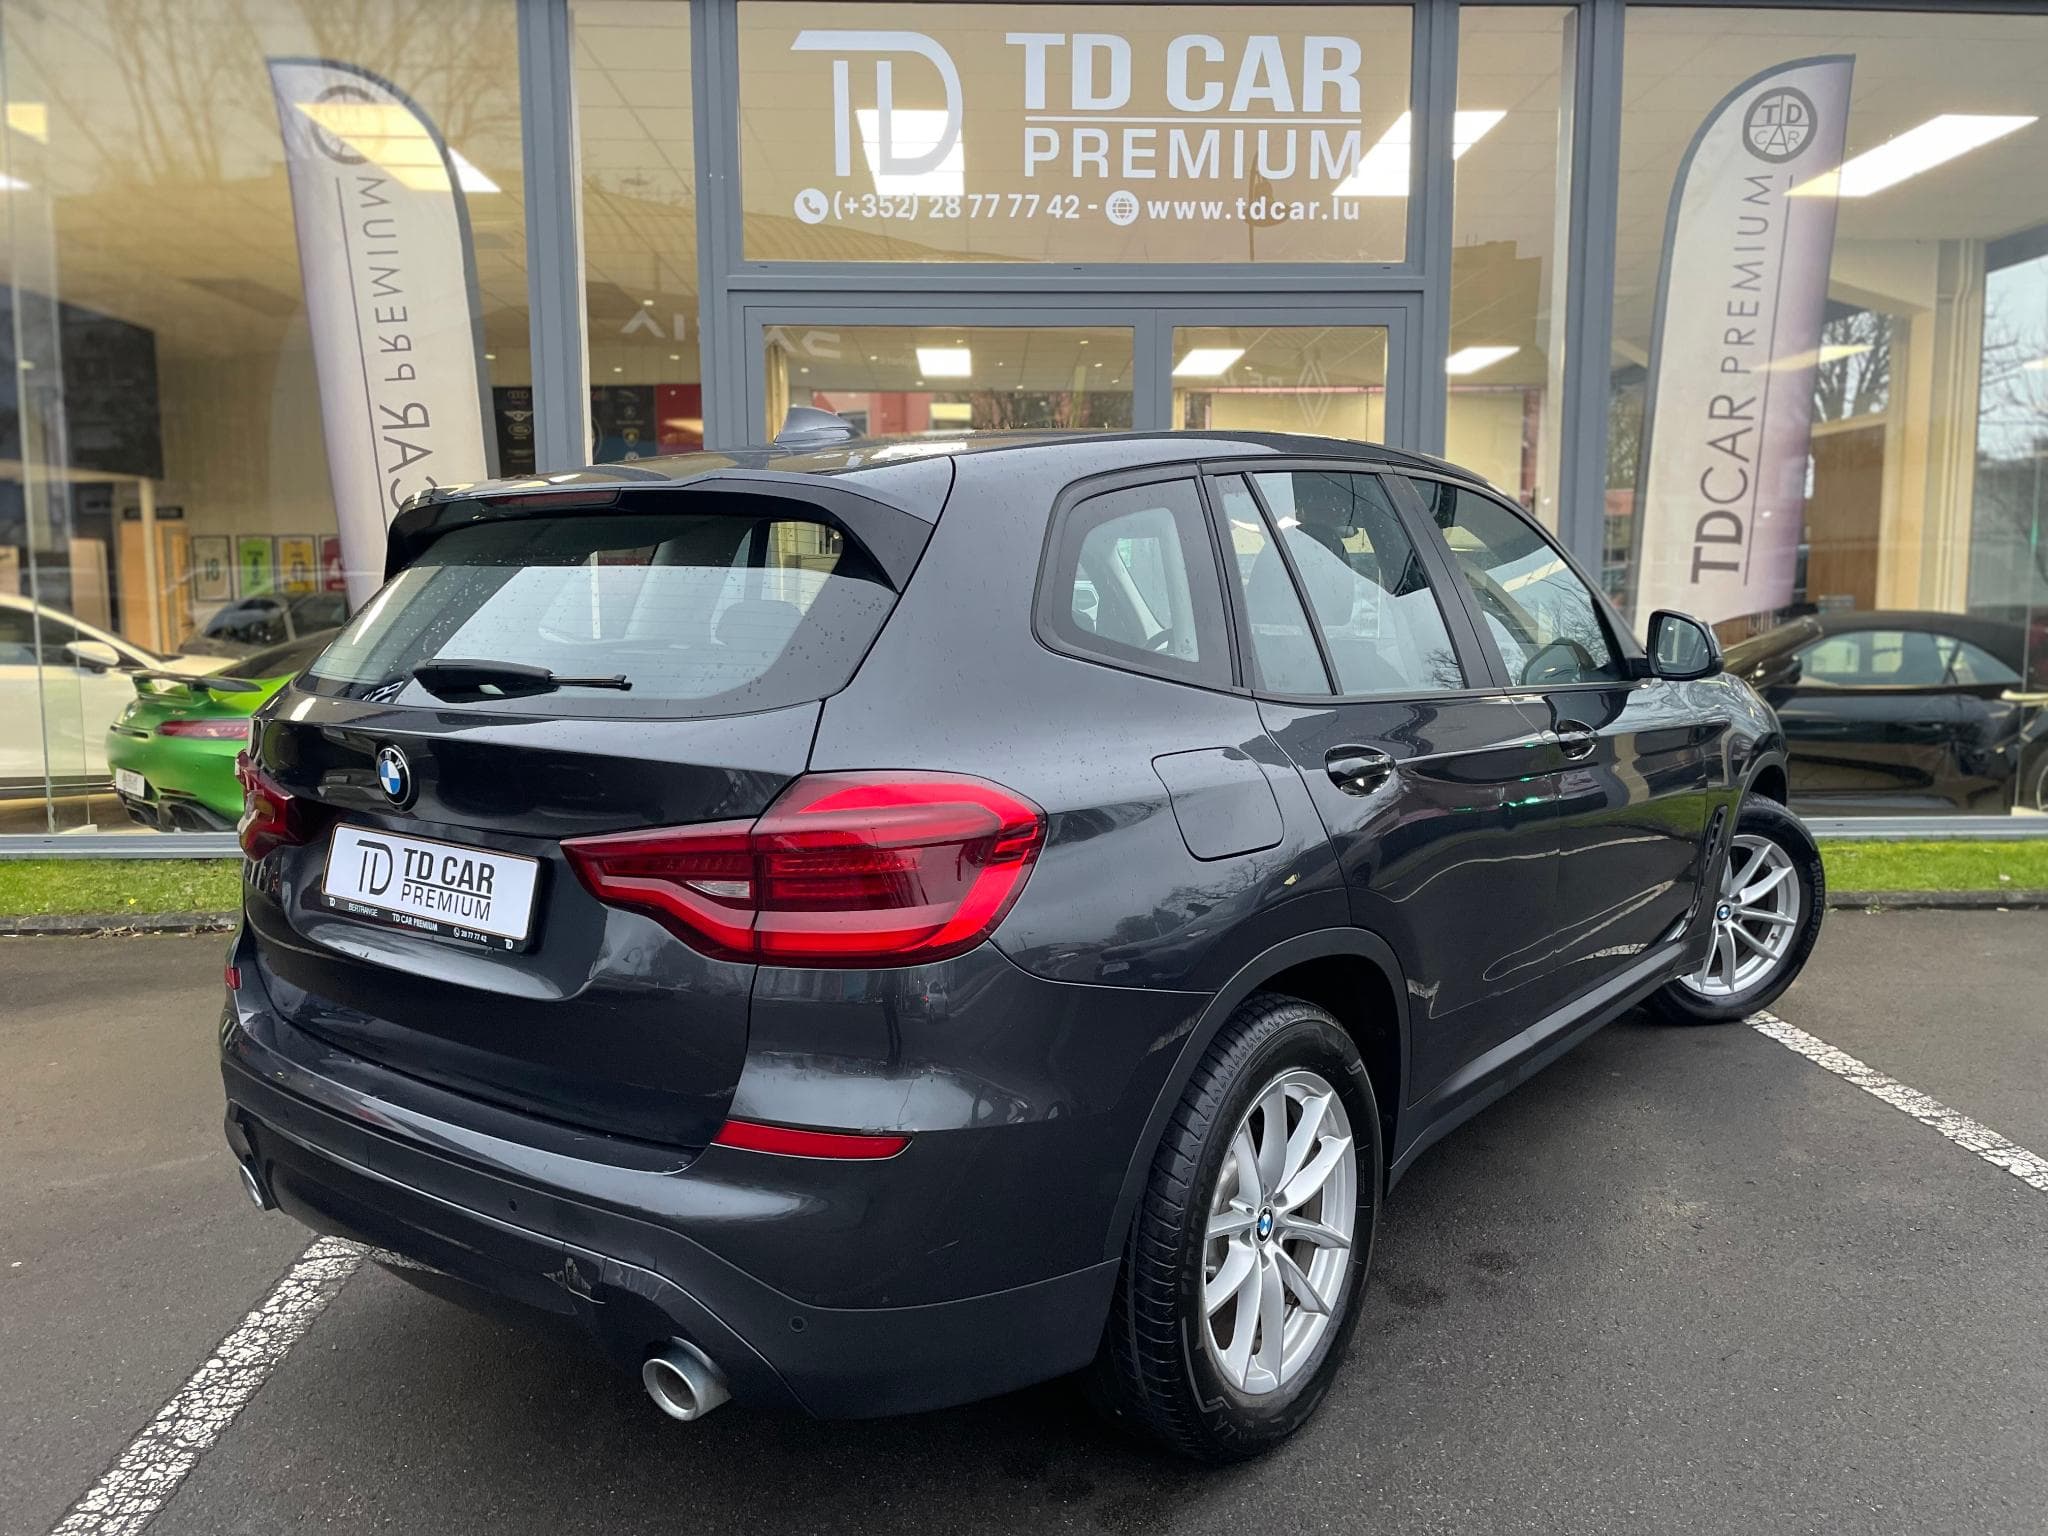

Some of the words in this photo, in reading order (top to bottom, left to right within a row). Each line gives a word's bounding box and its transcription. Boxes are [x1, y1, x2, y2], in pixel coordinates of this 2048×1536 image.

[1006, 32, 1131, 110] TD
[1166, 34, 1361, 113] CAR
[1024, 127, 1361, 180] PREMIUM
[833, 191, 919, 220] (+352)
[929, 194, 961, 218] 28
[967, 194, 1000, 218] 77
[1007, 194, 1041, 218] 77
[1046, 194, 1080, 219] 42
[1147, 196, 1360, 220] www.tdcar.lu
[1721, 175, 1774, 374] PREMIUM
[1690, 394, 1757, 584] TDCAR
[403, 848, 434, 880] TD
[441, 856, 495, 894] CAR
[348, 902, 378, 917] BERTRANGE
[392, 913, 401, 922] TD
[401, 915, 413, 925] CAR
[401, 883, 491, 922] PREMIUM
